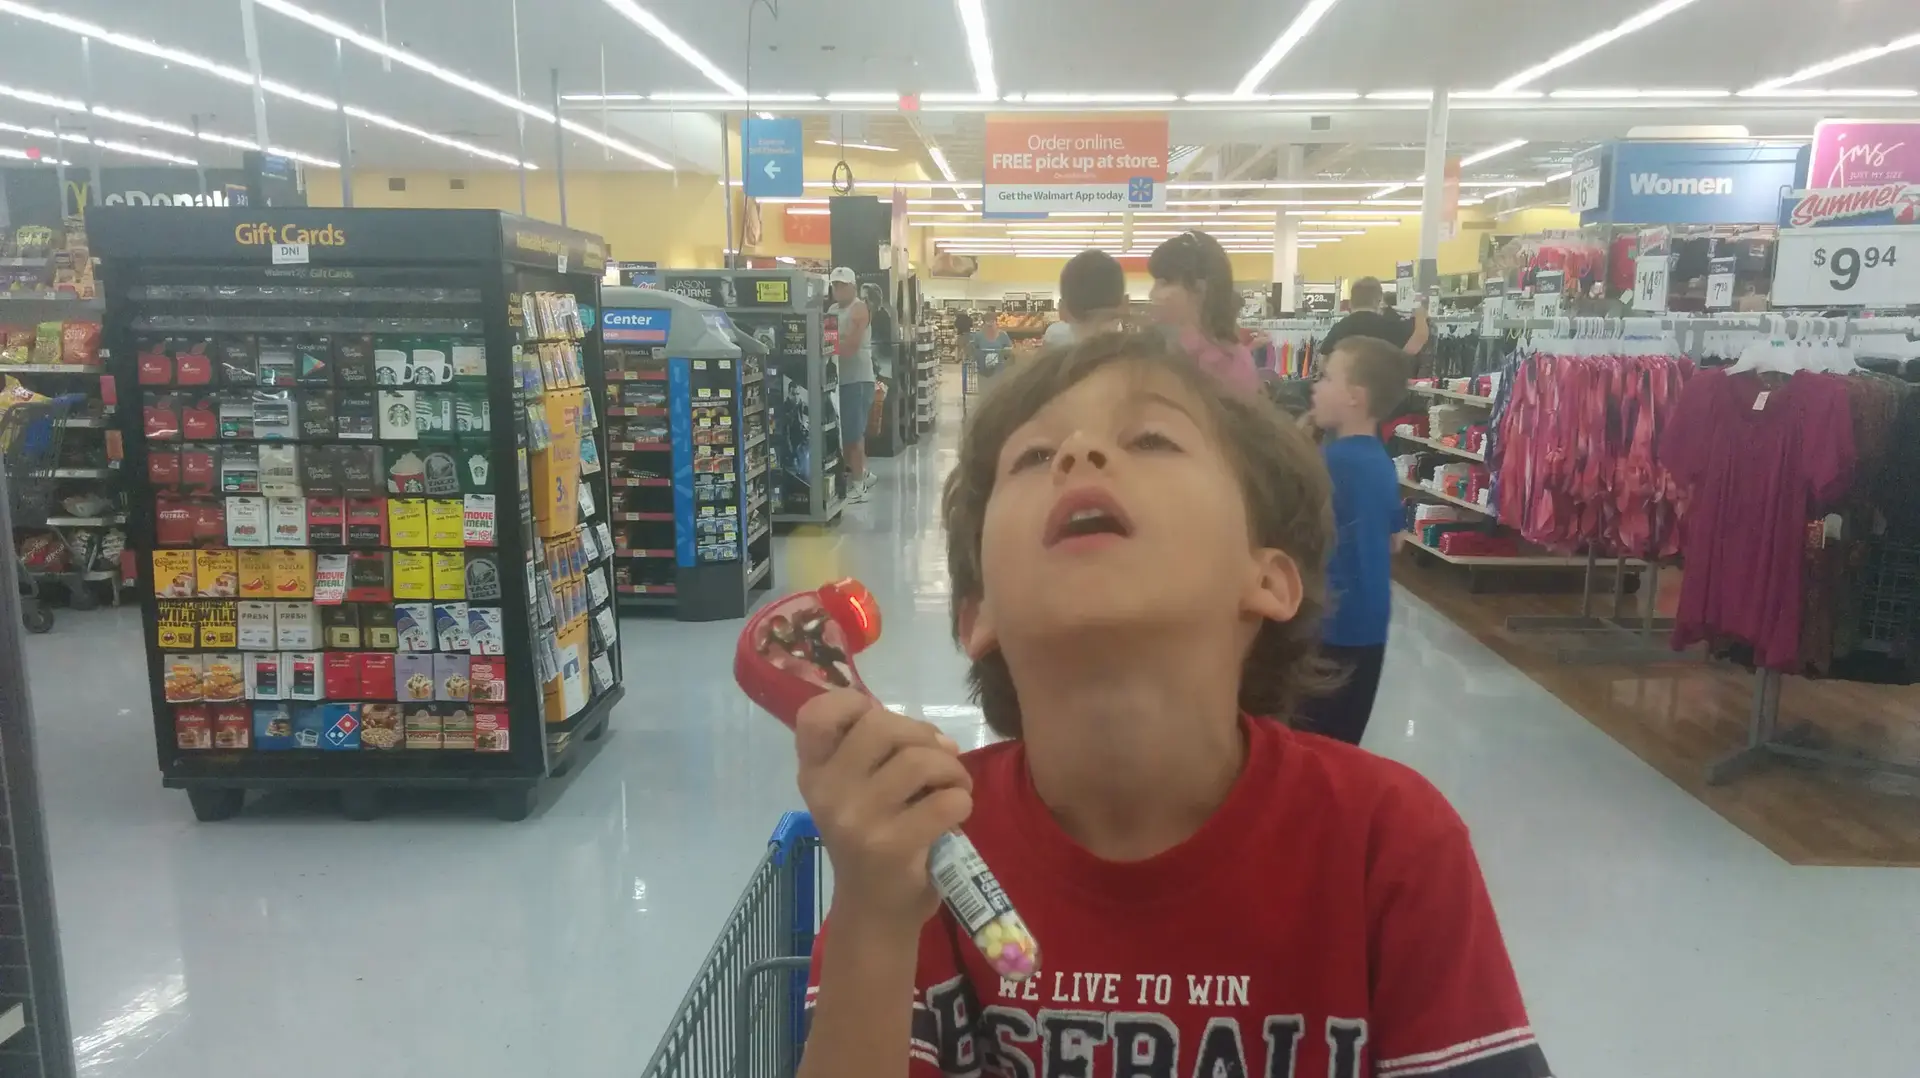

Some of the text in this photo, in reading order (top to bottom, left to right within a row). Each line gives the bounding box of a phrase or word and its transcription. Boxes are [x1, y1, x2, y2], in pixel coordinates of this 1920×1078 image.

[1028, 133, 1125, 151] Order online.
[992, 152, 1160, 173] FREE pick up at store.
[1848, 171, 1904, 181] JUST MY SIZE
[1629, 171, 1734, 197] Women
[998, 190, 1125, 203] Get the Walmart App today.
[1791, 184, 1907, 226] Summer
[235, 223, 346, 247] Gift Cards
[328, 268, 354, 279] Cards
[673, 280, 706, 289] JASON
[668, 288, 712, 298] BOURNE
[604, 312, 652, 326] Center
[464, 511, 493, 520] MOVIE
[317, 571, 345, 579] MOVIE
[280, 612, 307, 620] FRESH
[998, 970, 1251, 1006] WE LIVE TO WIN
[925, 973, 1369, 1078] BSEBALL
